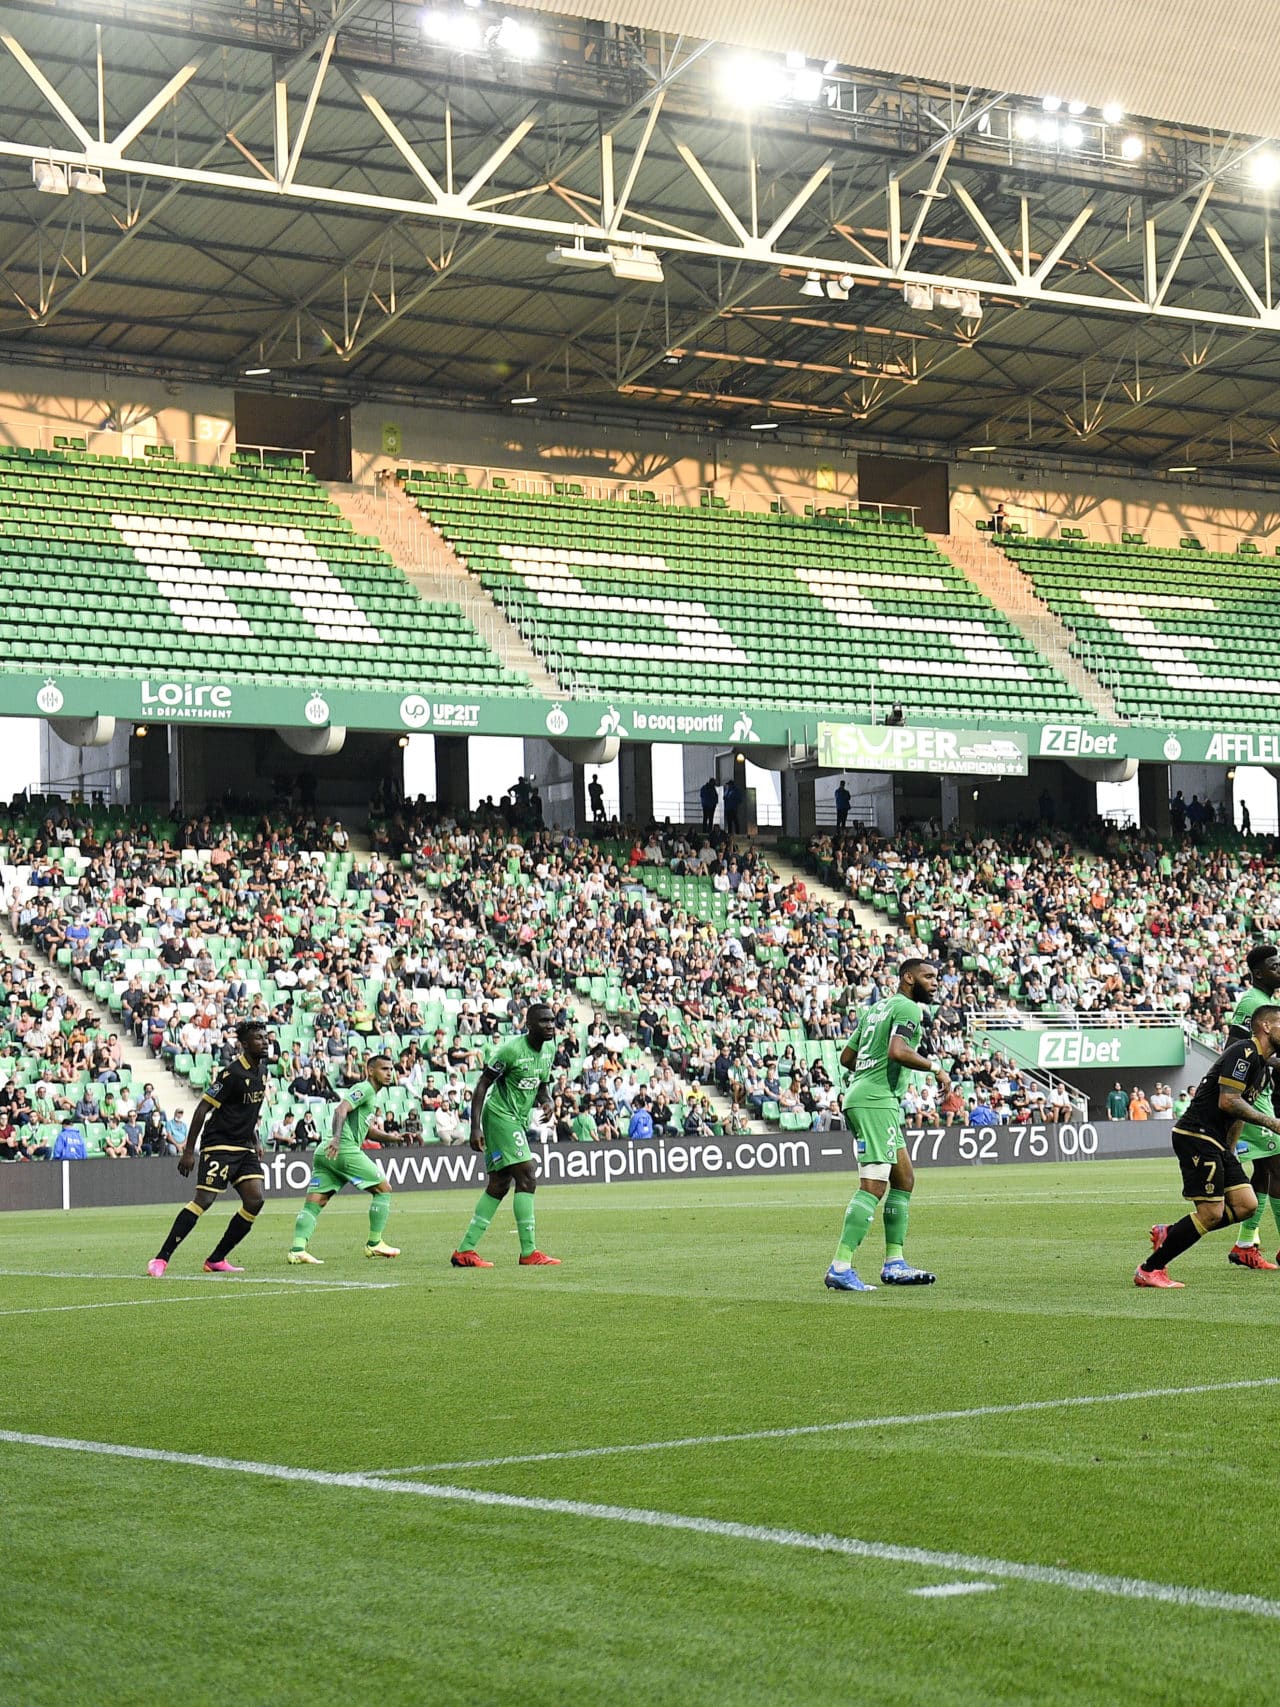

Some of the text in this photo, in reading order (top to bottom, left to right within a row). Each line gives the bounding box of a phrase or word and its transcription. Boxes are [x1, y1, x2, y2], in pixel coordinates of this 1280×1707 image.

[199, 420, 228, 440] 37
[141, 680, 232, 707] Loire
[142, 706, 232, 718] LE DÉPARTEMENT
[433, 703, 480, 721] UP2IT
[633, 711, 724, 734] le coq sportif
[838, 726, 960, 759] SUPER
[1041, 725, 1117, 755] ZEbet
[928, 760, 1006, 772] CHAMPIONS
[1040, 1033, 1121, 1065] ZEbet
[887, 1126, 897, 1146] 2
[906, 1129, 946, 1161] 77
[958, 1128, 998, 1160] 52
[1009, 1126, 1049, 1157] 75
[1058, 1123, 1098, 1155] 00
[207, 1160, 230, 1181] 24
[1203, 1161, 1217, 1182] 7
